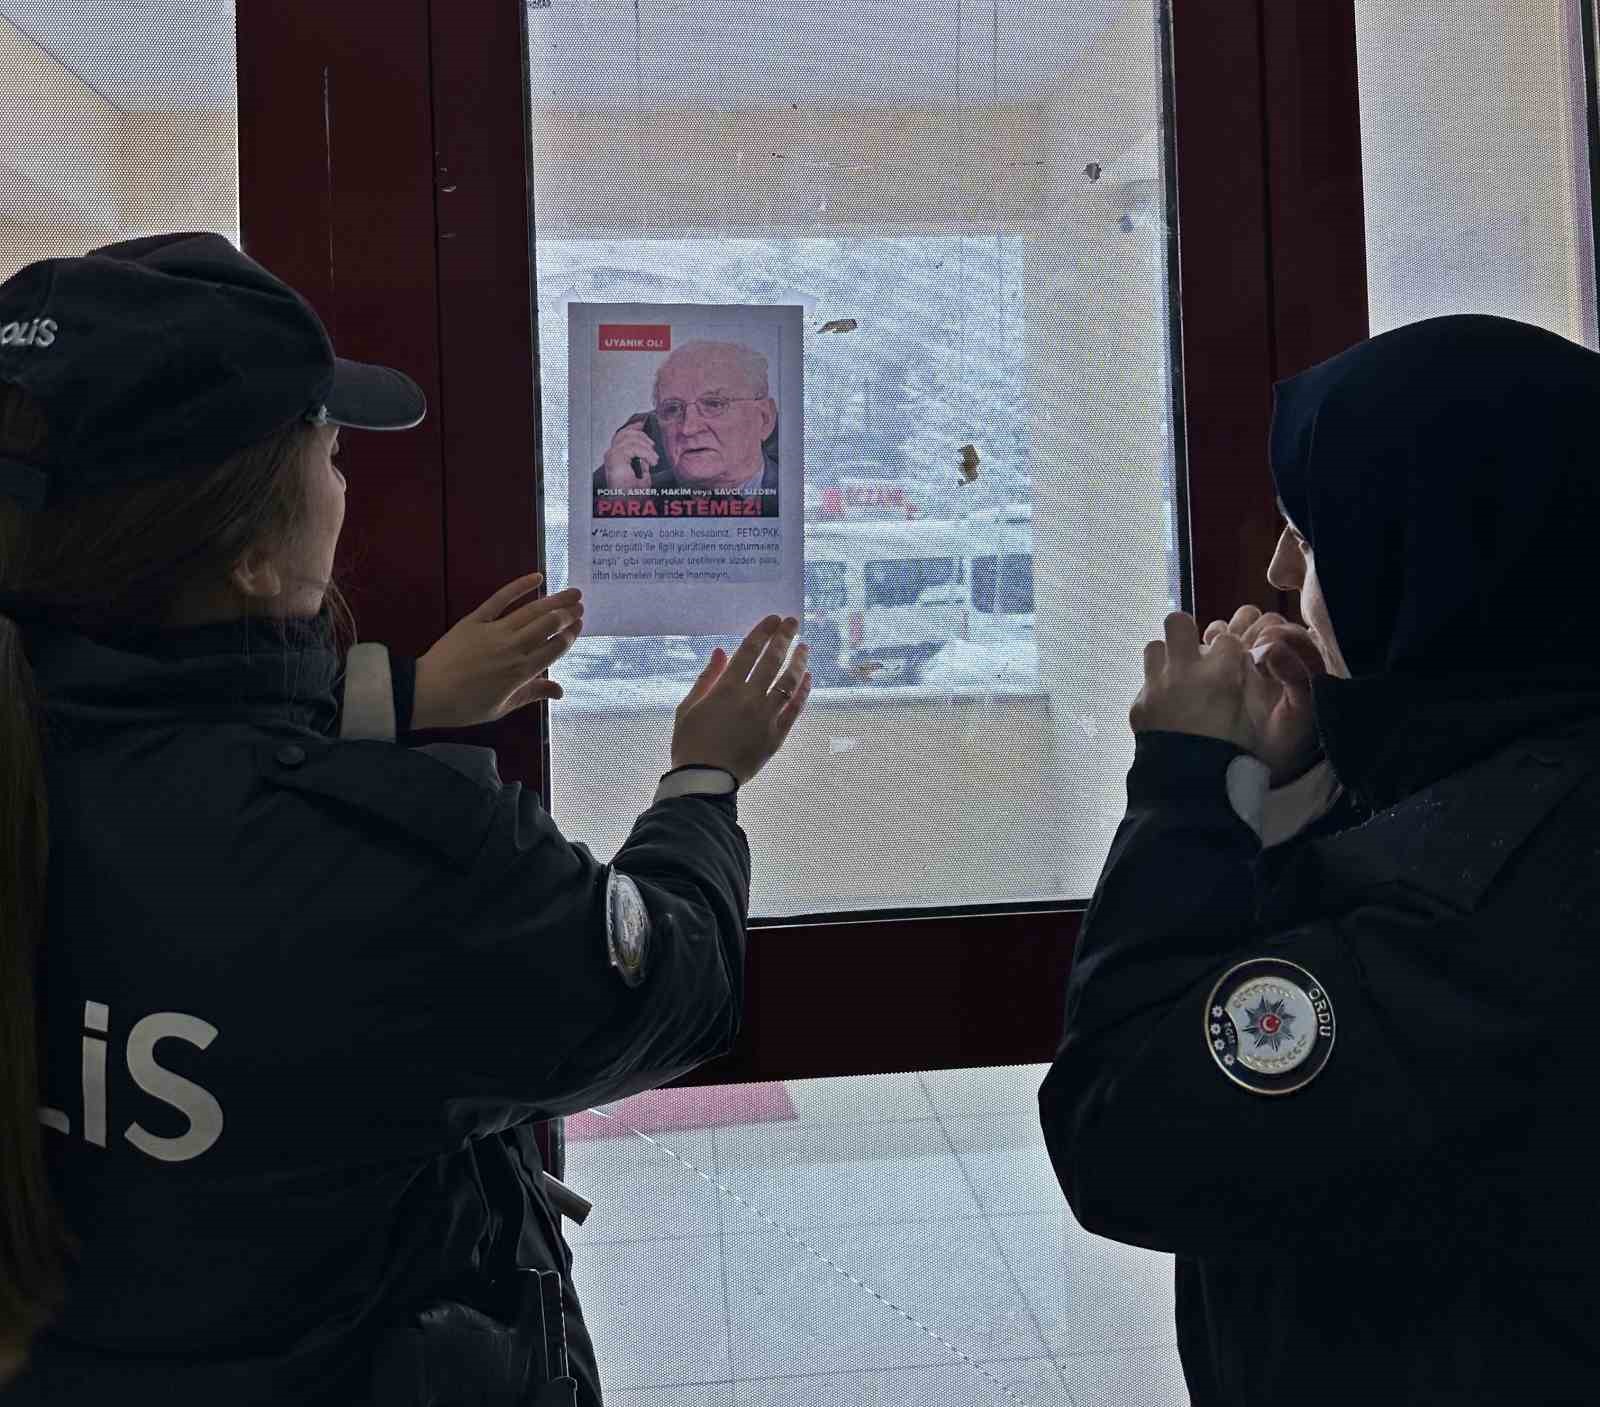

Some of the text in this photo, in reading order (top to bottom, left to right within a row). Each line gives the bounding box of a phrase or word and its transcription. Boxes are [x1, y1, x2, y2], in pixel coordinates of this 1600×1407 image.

[604, 338, 664, 348] UYANIK OL!
[627, 488, 659, 497] ASKER,
[693, 489, 712, 497] veya
[598, 501, 657, 516] PARA
[1308, 988, 1331, 1037] ORDU
